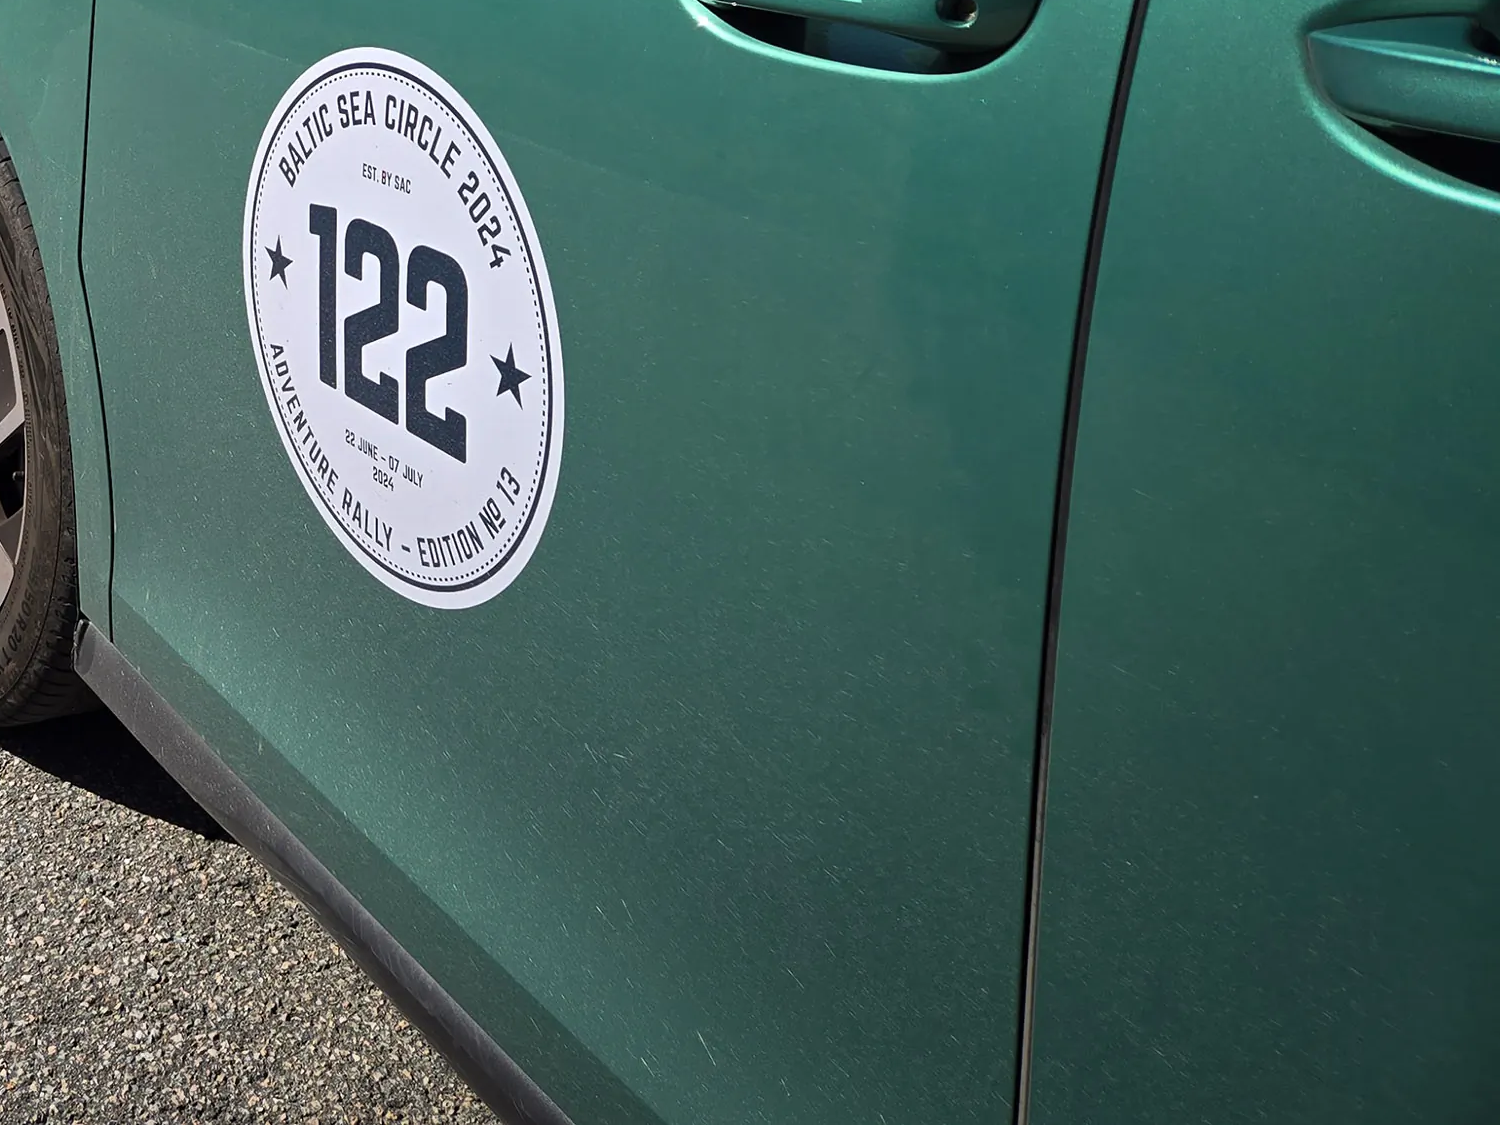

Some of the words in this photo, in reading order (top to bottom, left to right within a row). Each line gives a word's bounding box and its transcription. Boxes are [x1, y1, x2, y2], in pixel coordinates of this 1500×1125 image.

[278, 103, 333, 188] BALTIC
[336, 90, 376, 129] SEA
[384, 94, 462, 179] CIRCLE
[456, 170, 511, 270] 2024
[362, 162, 380, 183] EST.
[381, 168, 394, 187] BY
[394, 174, 411, 195] SAC
[309, 203, 468, 464] 122
[270, 343, 339, 495] ADVENTURE
[341, 487, 393, 552] RALLY
[417, 521, 485, 568] EDITION
[496, 466, 521, 506] 13
[345, 428, 356, 448] 22
[357, 436, 379, 462] JUNE
[388, 453, 400, 474] 07
[402, 463, 424, 489] JULY
[372, 465, 395, 492] 2024
